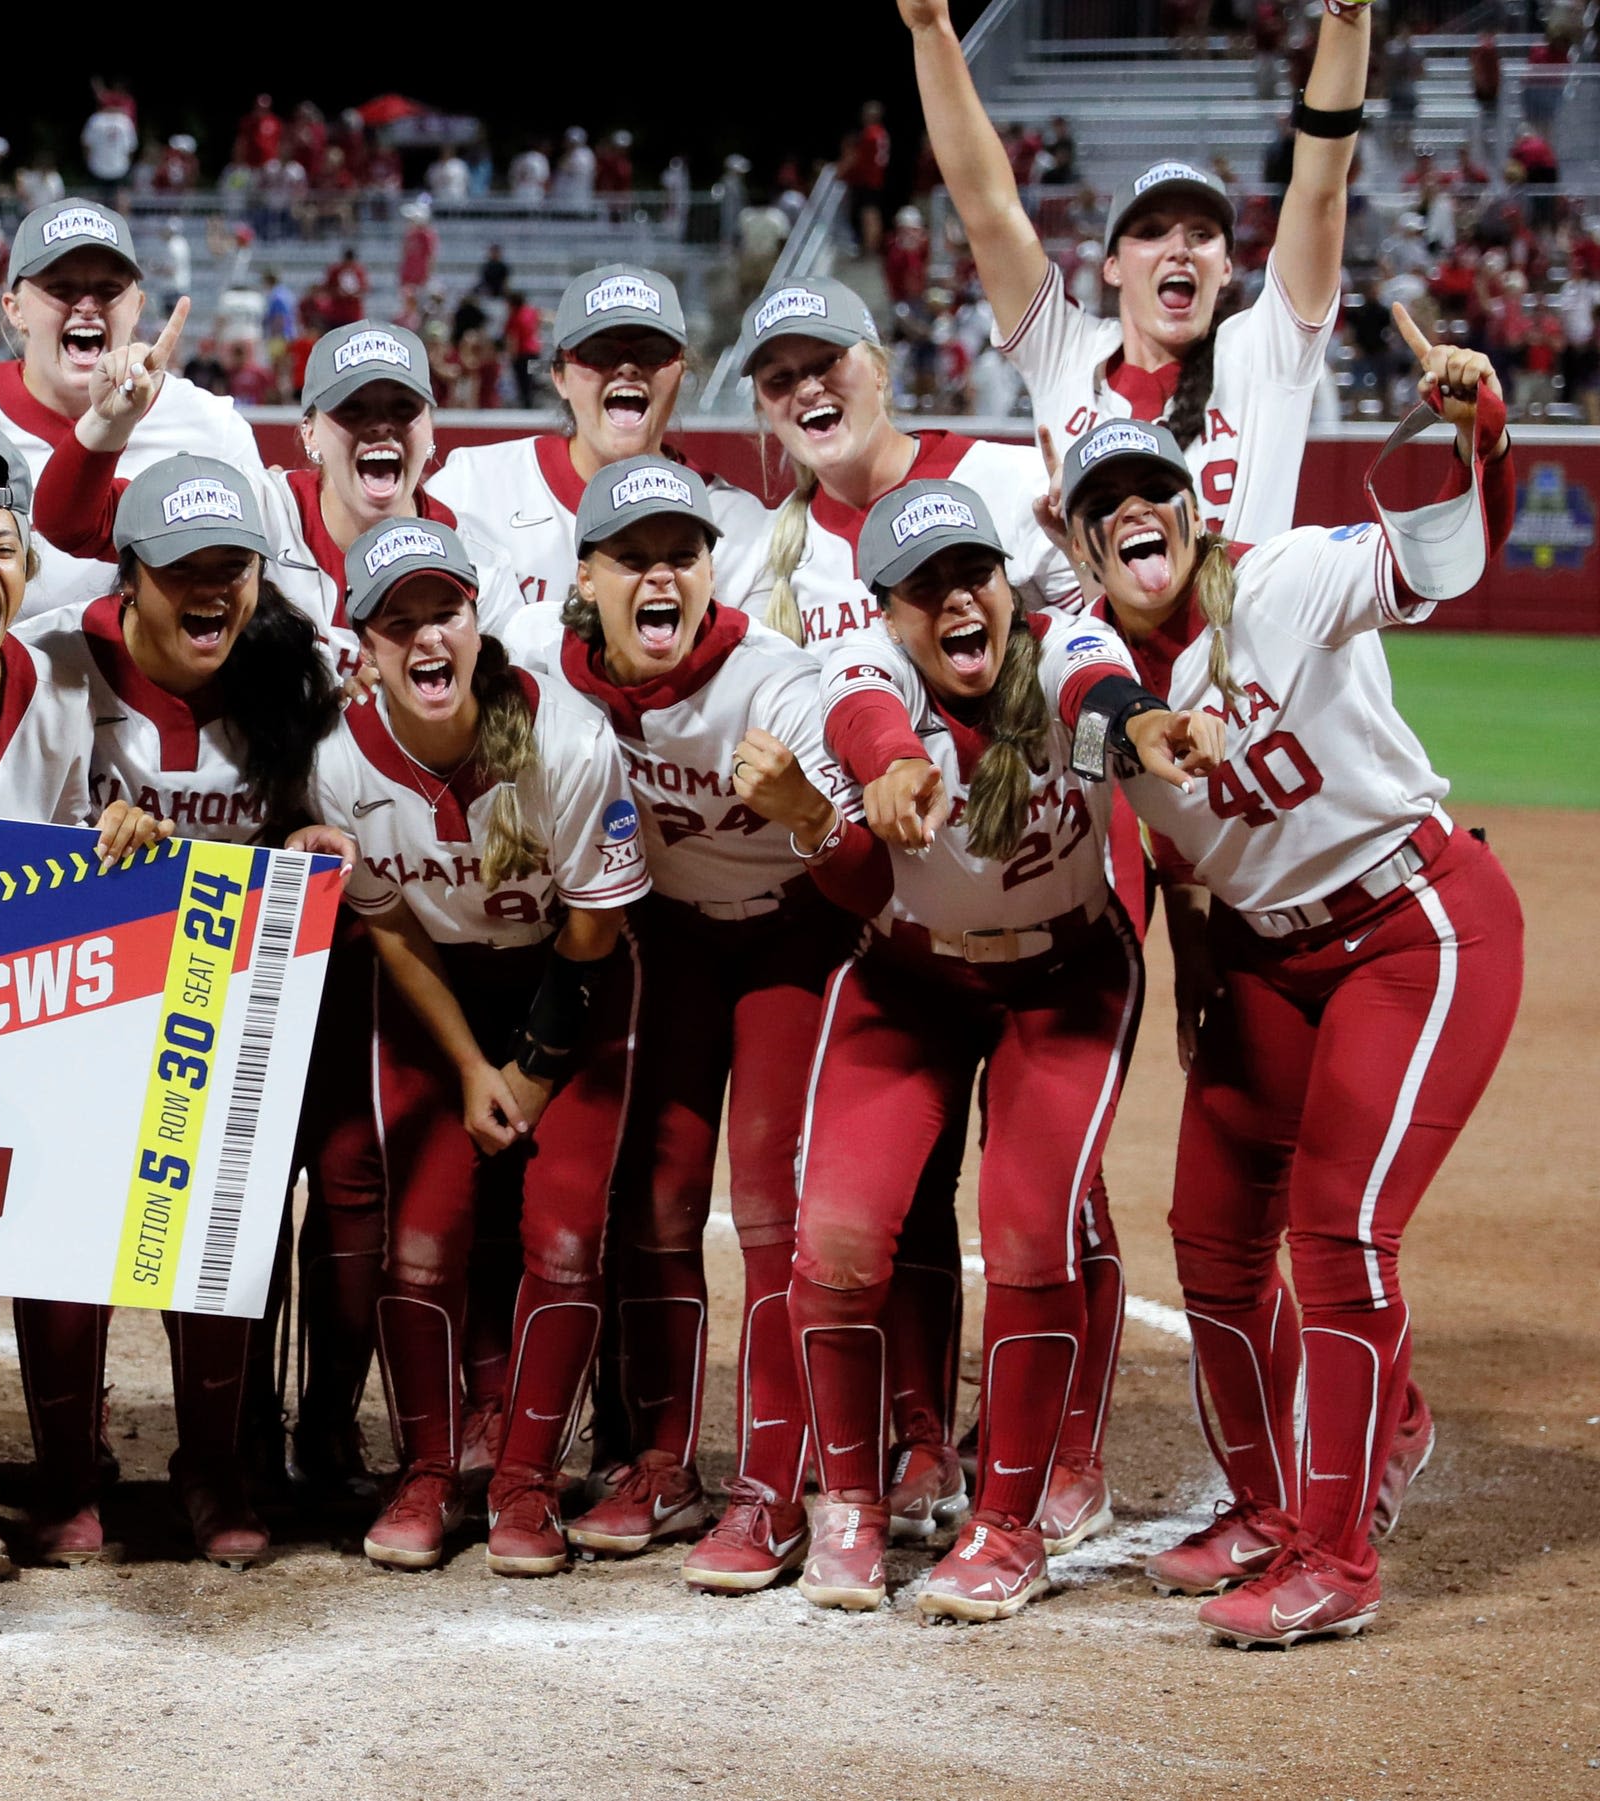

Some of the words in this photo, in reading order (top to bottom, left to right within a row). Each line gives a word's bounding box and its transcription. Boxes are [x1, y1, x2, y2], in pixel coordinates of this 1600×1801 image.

[48, 217, 114, 238] CHAMPS
[591, 286, 656, 308] CHAMPS
[758, 296, 821, 329] CHAMPS
[340, 340, 406, 364] CHAMPS
[1084, 431, 1155, 460] CHAMPS
[170, 490, 237, 516] CHAMPS
[618, 477, 687, 502] CHAMPS
[188, 506, 226, 515] 2024
[898, 503, 970, 535] CHAMPS
[370, 535, 440, 567] CHAMPS
[629, 753, 736, 798] HOM
[1207, 730, 1324, 828] 40
[608, 814, 636, 832] NCAA
[183, 869, 243, 951] 24
[183, 952, 216, 1008] SEAT
[157, 1011, 216, 1090] 30
[157, 1089, 191, 1143] ROW
[138, 1148, 191, 1191] 5
[133, 1192, 173, 1286] SECTION
